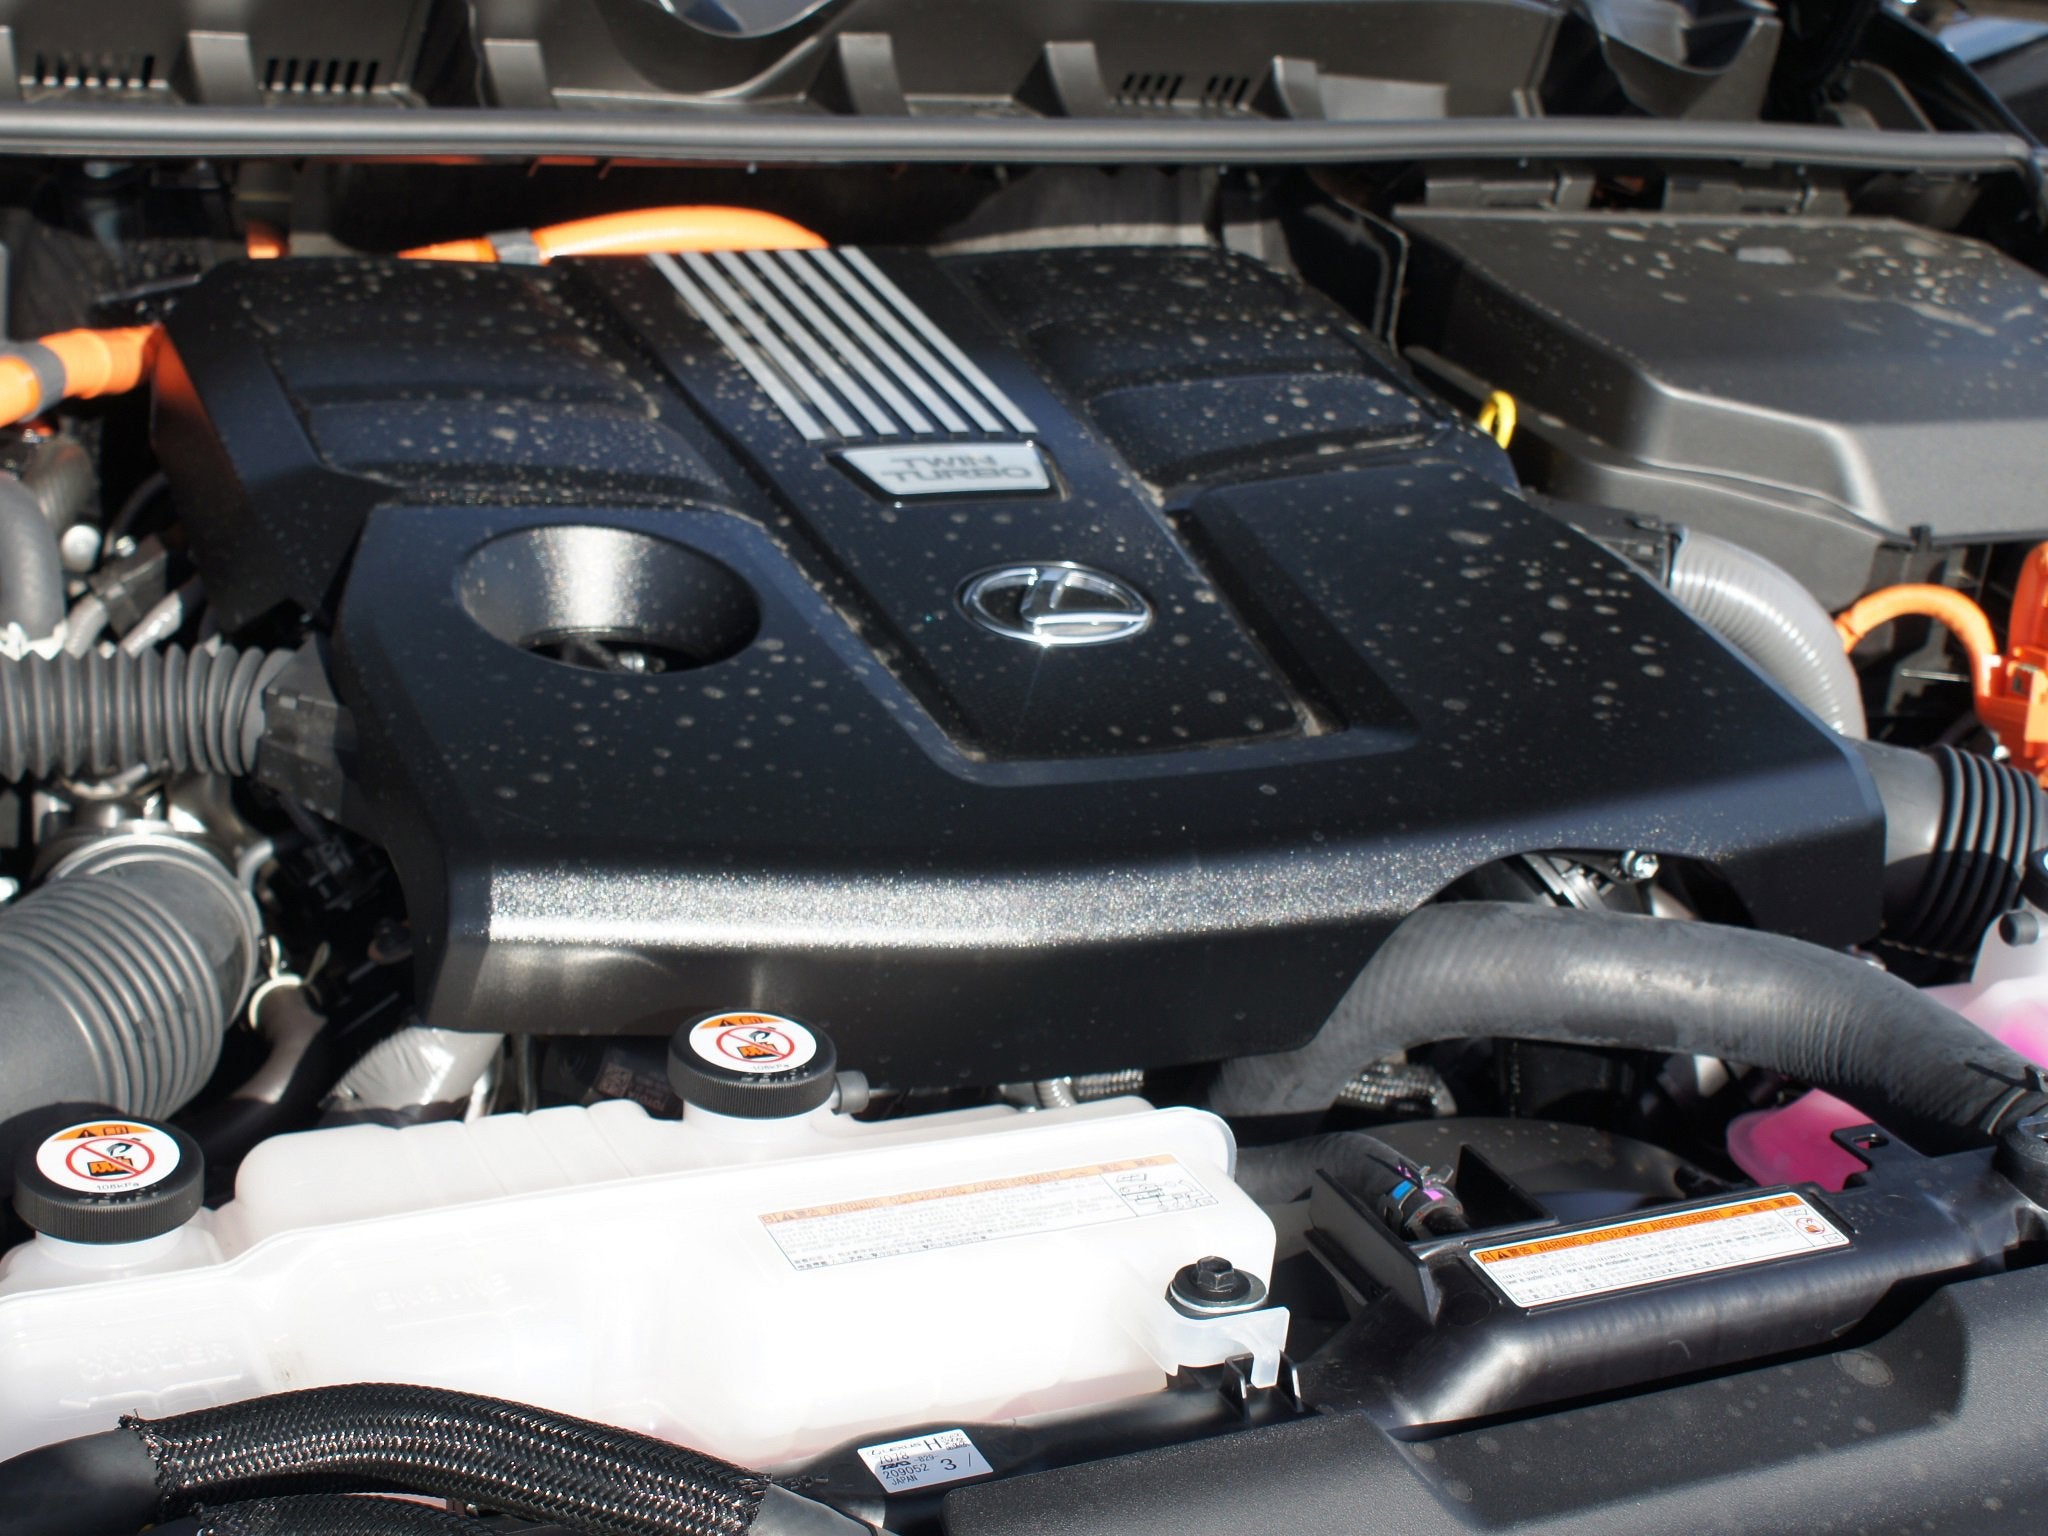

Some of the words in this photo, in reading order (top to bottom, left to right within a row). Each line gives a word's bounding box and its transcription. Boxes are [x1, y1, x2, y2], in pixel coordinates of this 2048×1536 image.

[890, 454, 997, 469] TWIN
[881, 466, 1032, 482] TURBO
[1535, 1236, 1582, 1252] WARNING
[1652, 1210, 1722, 1231] AVERTISSEMENT
[923, 1438, 942, 1451] H
[882, 1463, 930, 1480] 209052
[940, 1458, 957, 1471] 3
[891, 1474, 918, 1486] JAPAN
